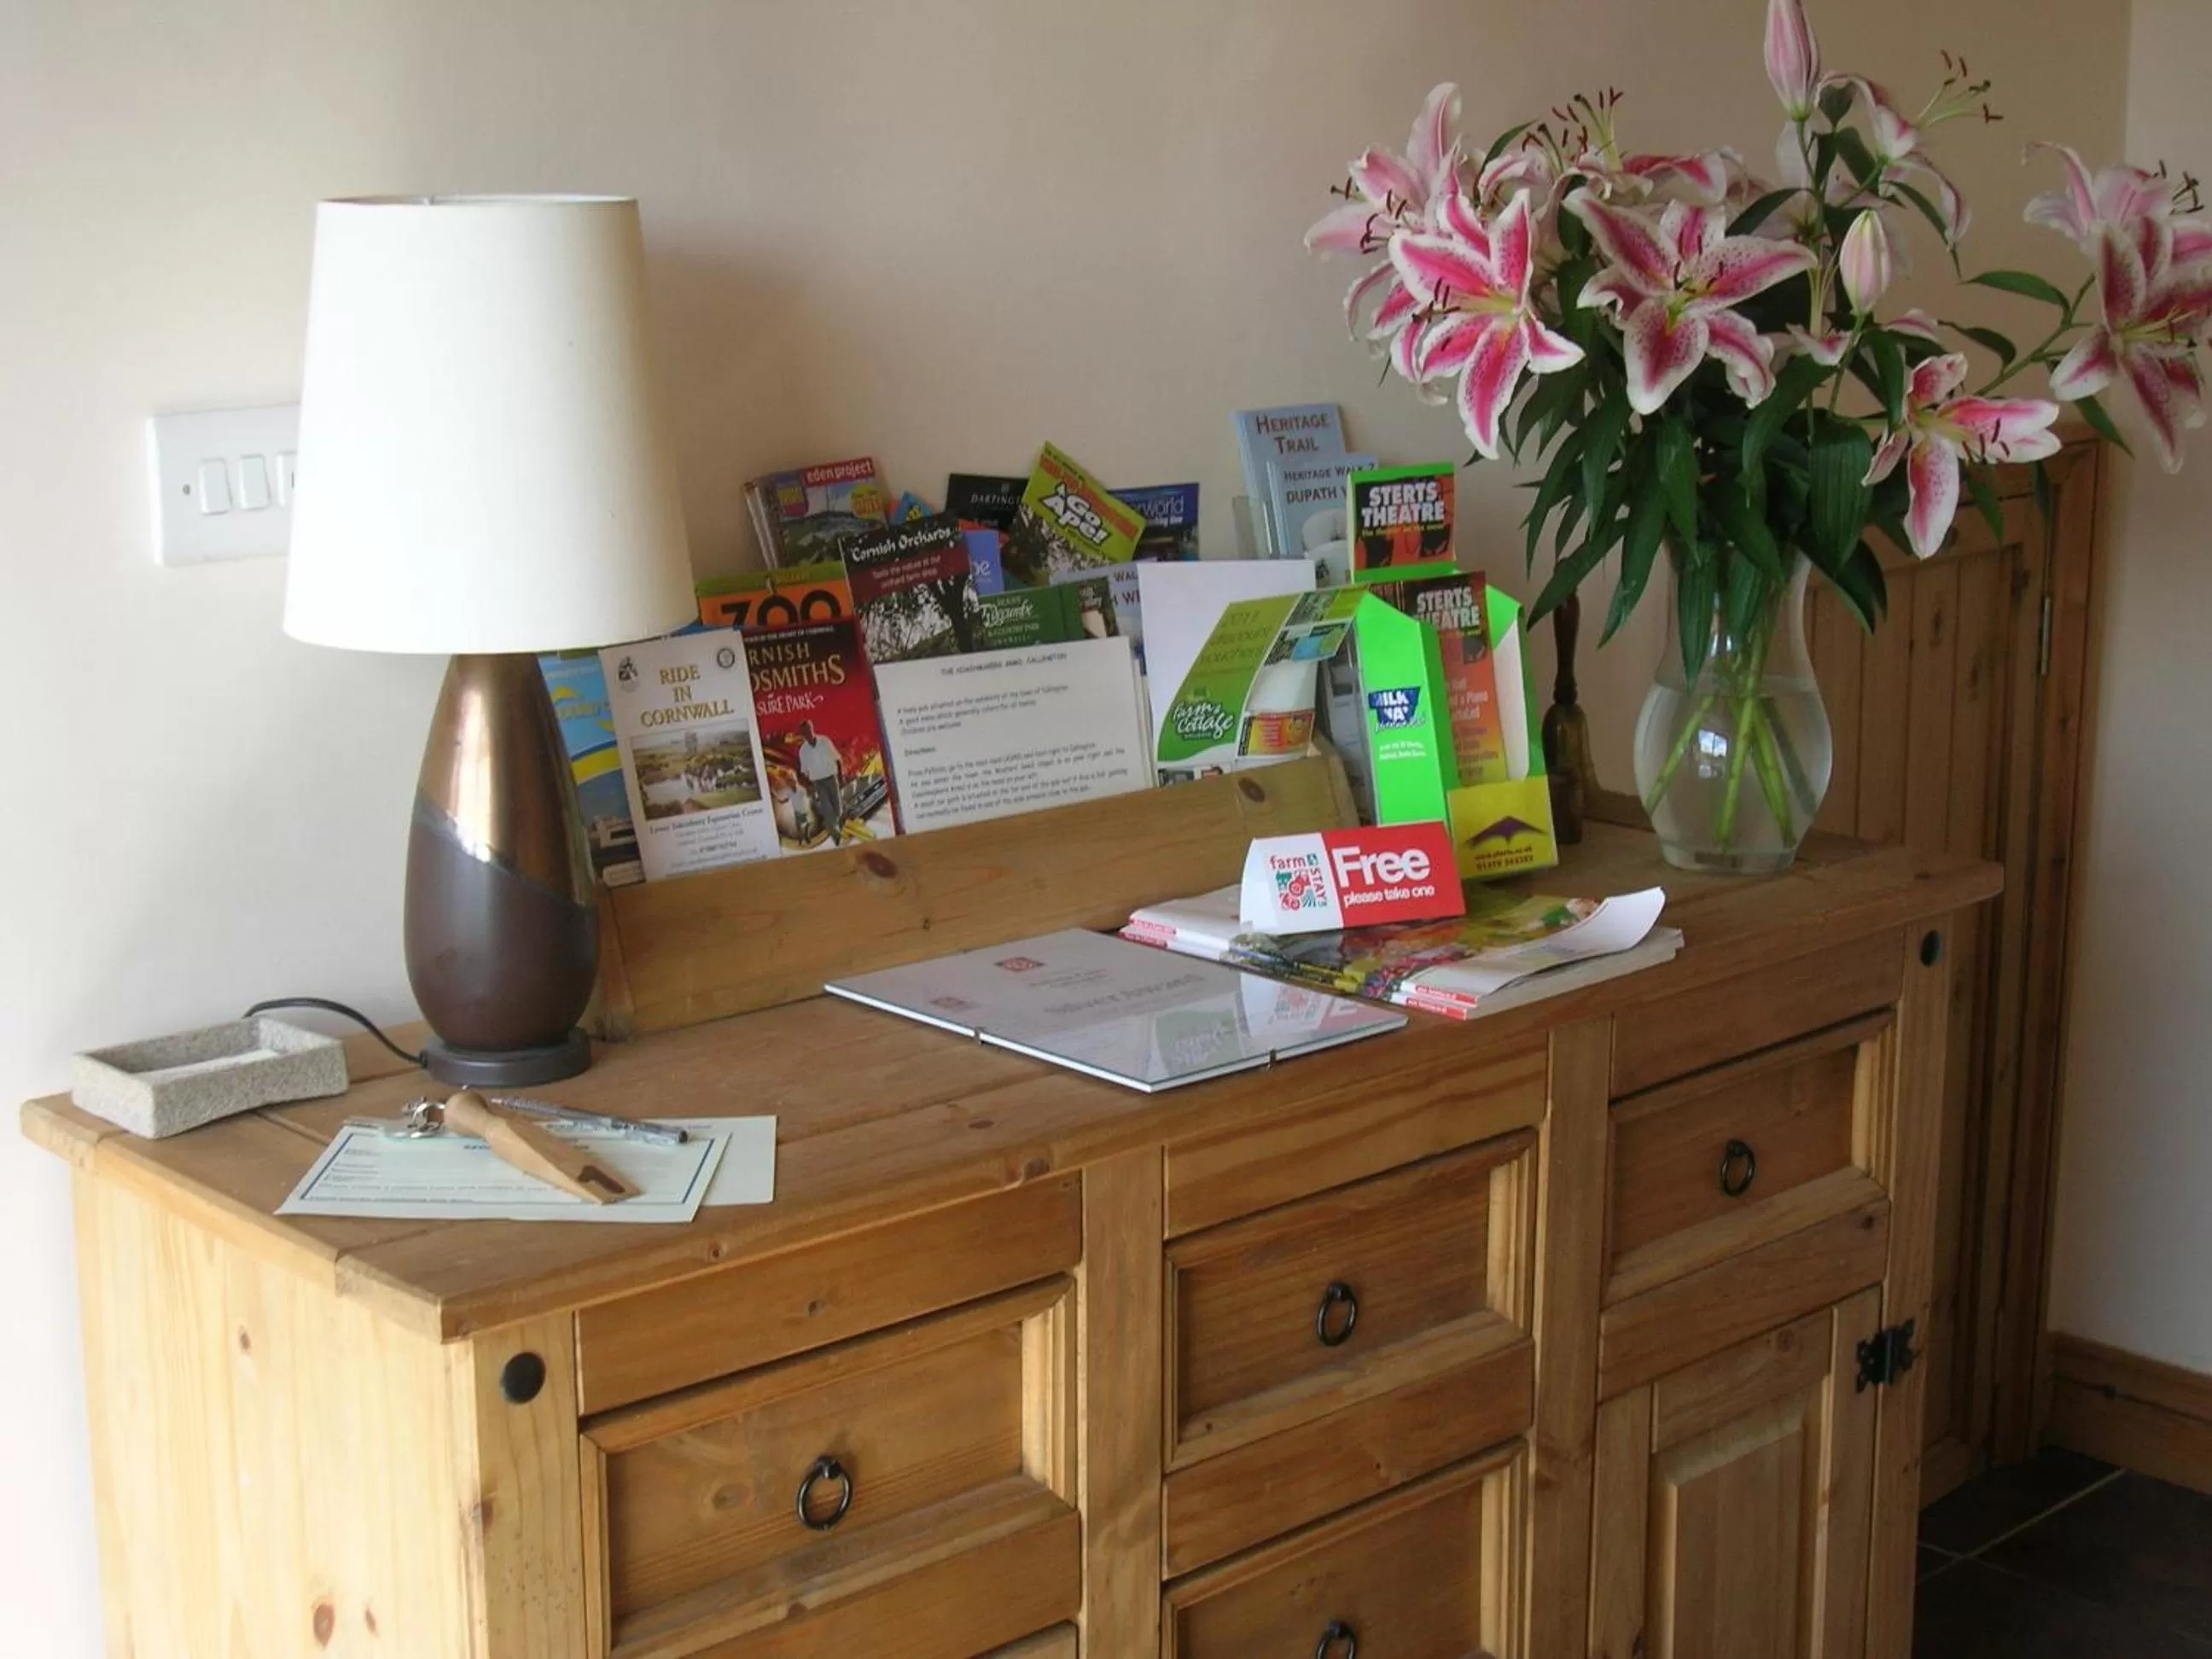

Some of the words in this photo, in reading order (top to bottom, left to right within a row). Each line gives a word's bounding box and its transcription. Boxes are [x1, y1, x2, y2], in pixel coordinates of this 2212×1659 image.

[1255, 413, 1329, 434] HERITAGE
[1274, 436, 1319, 455] TRAIL
[835, 460, 872, 480] project
[1284, 469, 1332, 482] HERITAGE
[1286, 487, 1338, 505] DUPATH
[1369, 480, 1439, 507] STERTS
[1065, 494, 1103, 528] Go
[1361, 500, 1445, 528] THEATRE
[851, 538, 896, 562] Cornish
[898, 527, 952, 550] Orchards
[1114, 571, 1138, 583] WAL
[720, 590, 842, 628] ZOO
[1416, 586, 1473, 614] STERTS
[748, 641, 810, 667] RNISH
[659, 665, 701, 685] RIDE
[750, 654, 846, 693] DSMITHS
[672, 685, 692, 703] IN
[640, 699, 735, 729] CORNWALL
[1270, 855, 1307, 870] farm
[1331, 846, 1431, 888] Free
[1311, 867, 1328, 899] STAY
[1342, 890, 1383, 908] please
[1384, 887, 1410, 900] take
[1412, 884, 1435, 898] one
